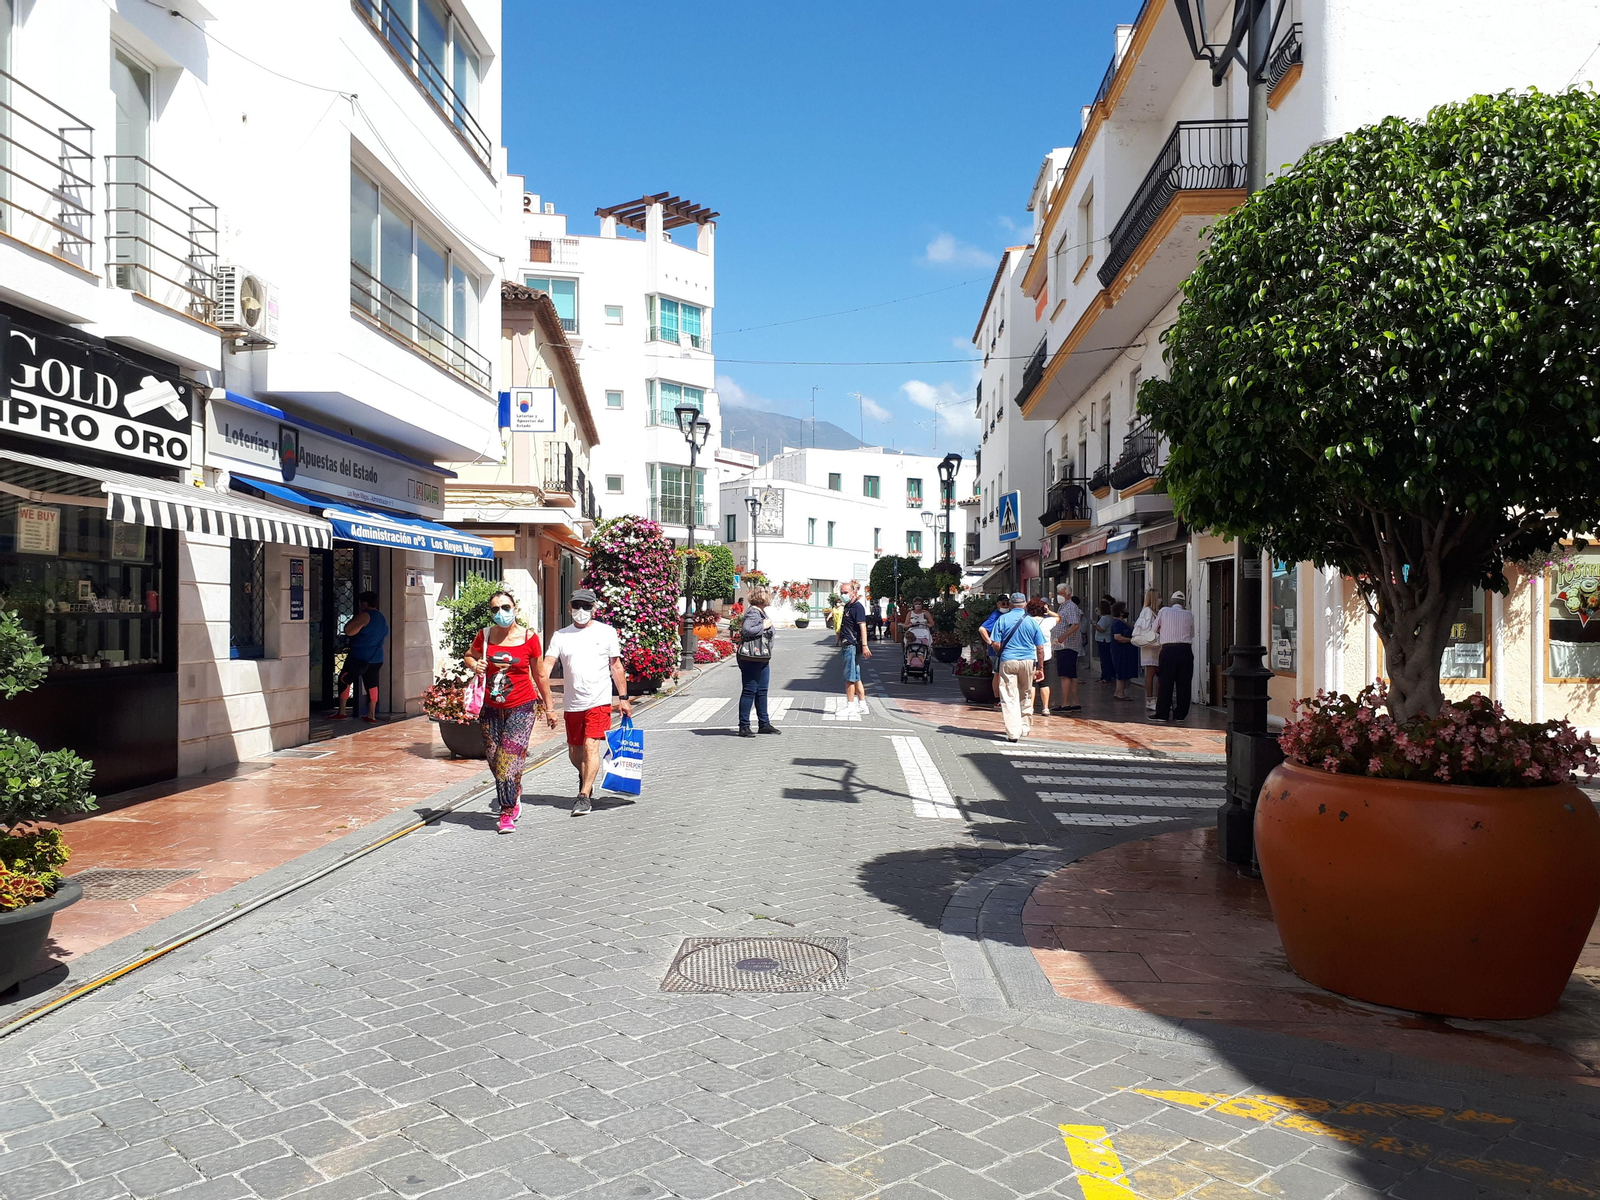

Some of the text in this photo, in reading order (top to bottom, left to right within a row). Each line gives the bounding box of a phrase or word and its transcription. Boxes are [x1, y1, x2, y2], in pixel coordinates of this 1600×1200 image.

[114, 424, 188, 461] ORO
[225, 423, 378, 485] Loterías y Apuestas del Estado
[20, 509, 56, 522] WE BUY
[350, 523, 412, 545] Administración
[431, 537, 443, 551] Los
[444, 540, 463, 554] Reyes
[463, 543, 484, 557] Magos
